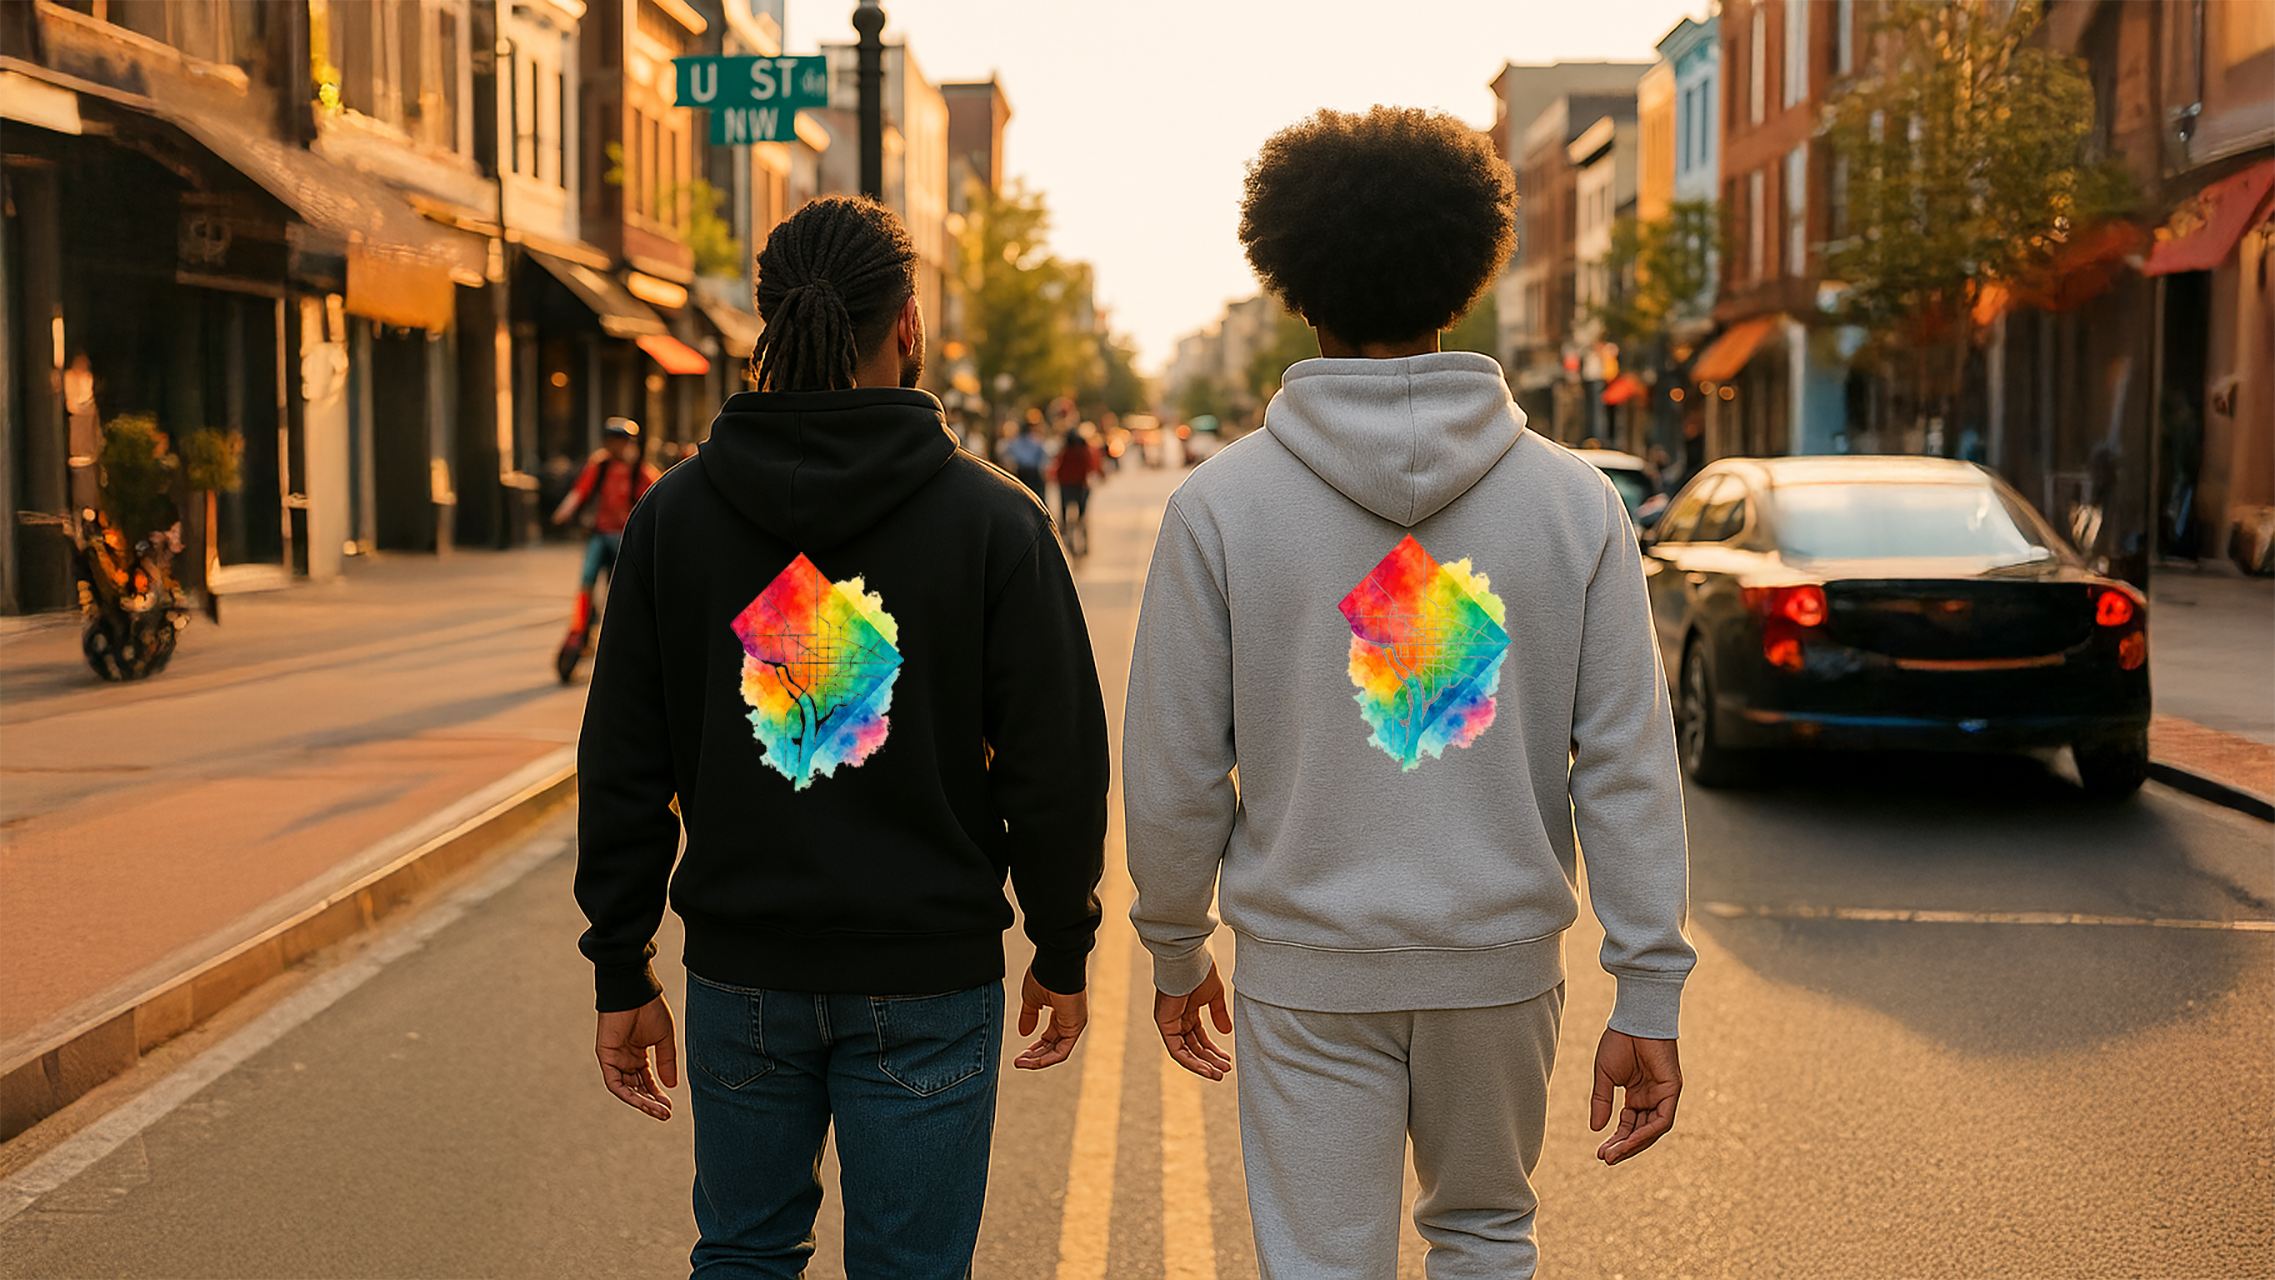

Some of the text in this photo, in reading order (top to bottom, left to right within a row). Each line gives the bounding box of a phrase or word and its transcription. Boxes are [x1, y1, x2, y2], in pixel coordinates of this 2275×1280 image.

[690, 61, 718, 103] U
[750, 58, 798, 100] ST
[724, 106, 779, 143] NW
